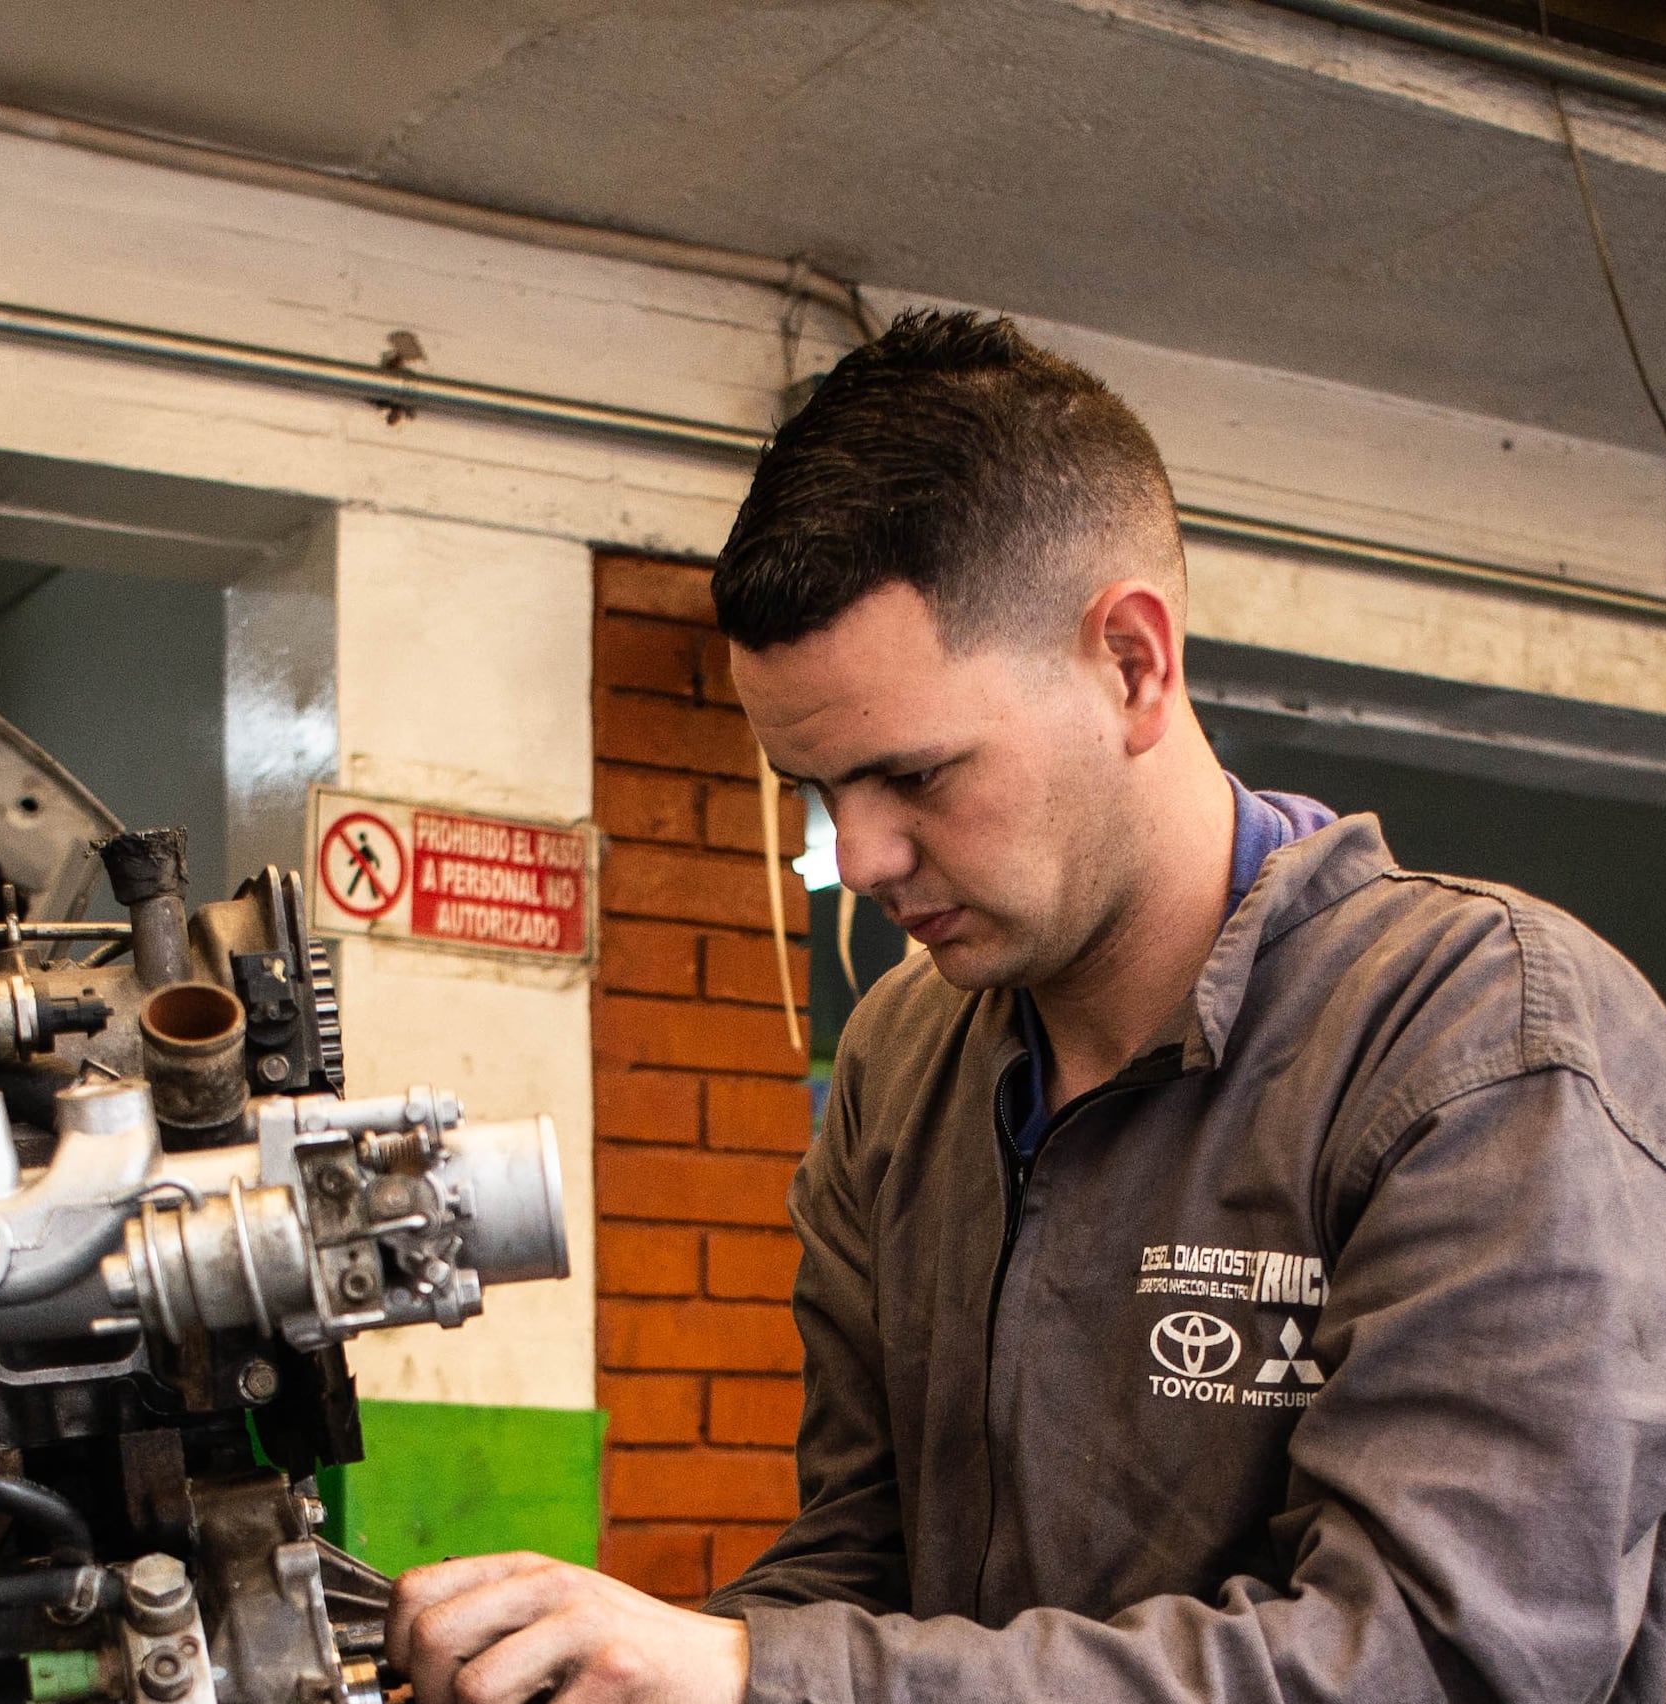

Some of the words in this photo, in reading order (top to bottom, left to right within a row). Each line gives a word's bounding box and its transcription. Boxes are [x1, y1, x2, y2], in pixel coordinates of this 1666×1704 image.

[417, 816, 511, 861] PROHIBIDO
[512, 830, 534, 865] EL
[421, 859, 437, 892] A
[440, 860, 542, 905] PERSONAL
[544, 875, 575, 909] NO
[436, 902, 560, 948] AUTORIZADO
[1210, 1281, 1252, 1300] ELECTRO
[1149, 1375, 1235, 1403] TOYOTA
